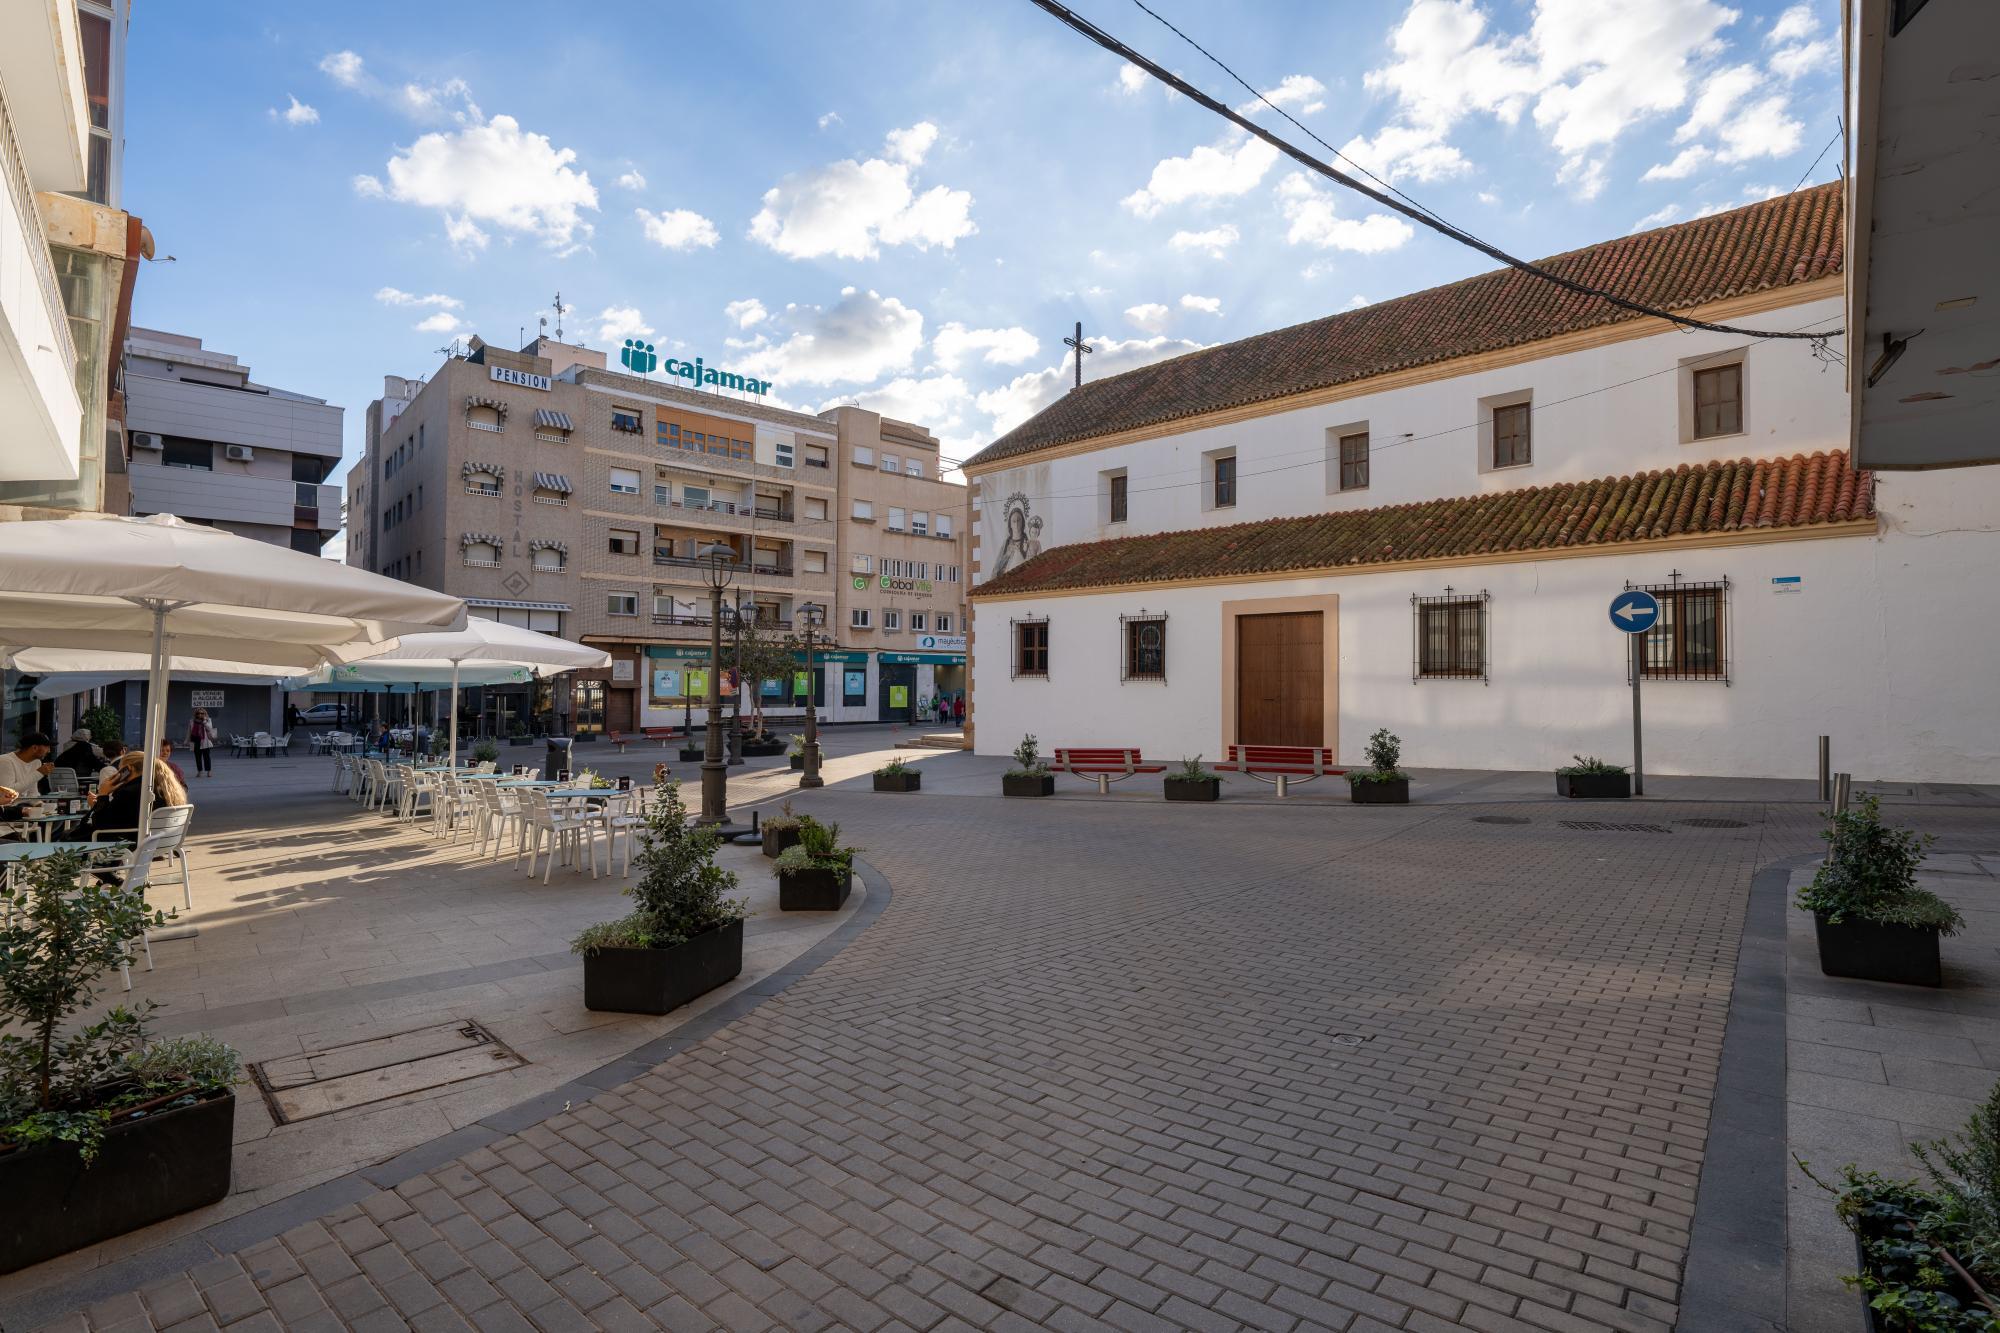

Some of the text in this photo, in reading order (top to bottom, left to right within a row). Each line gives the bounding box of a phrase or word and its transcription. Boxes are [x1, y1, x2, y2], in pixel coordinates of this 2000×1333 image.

[496, 367, 547, 390] PENSION
[664, 357, 773, 396] cajamar
[513, 470, 523, 558] HOSTAL
[684, 648, 707, 657] cajamar
